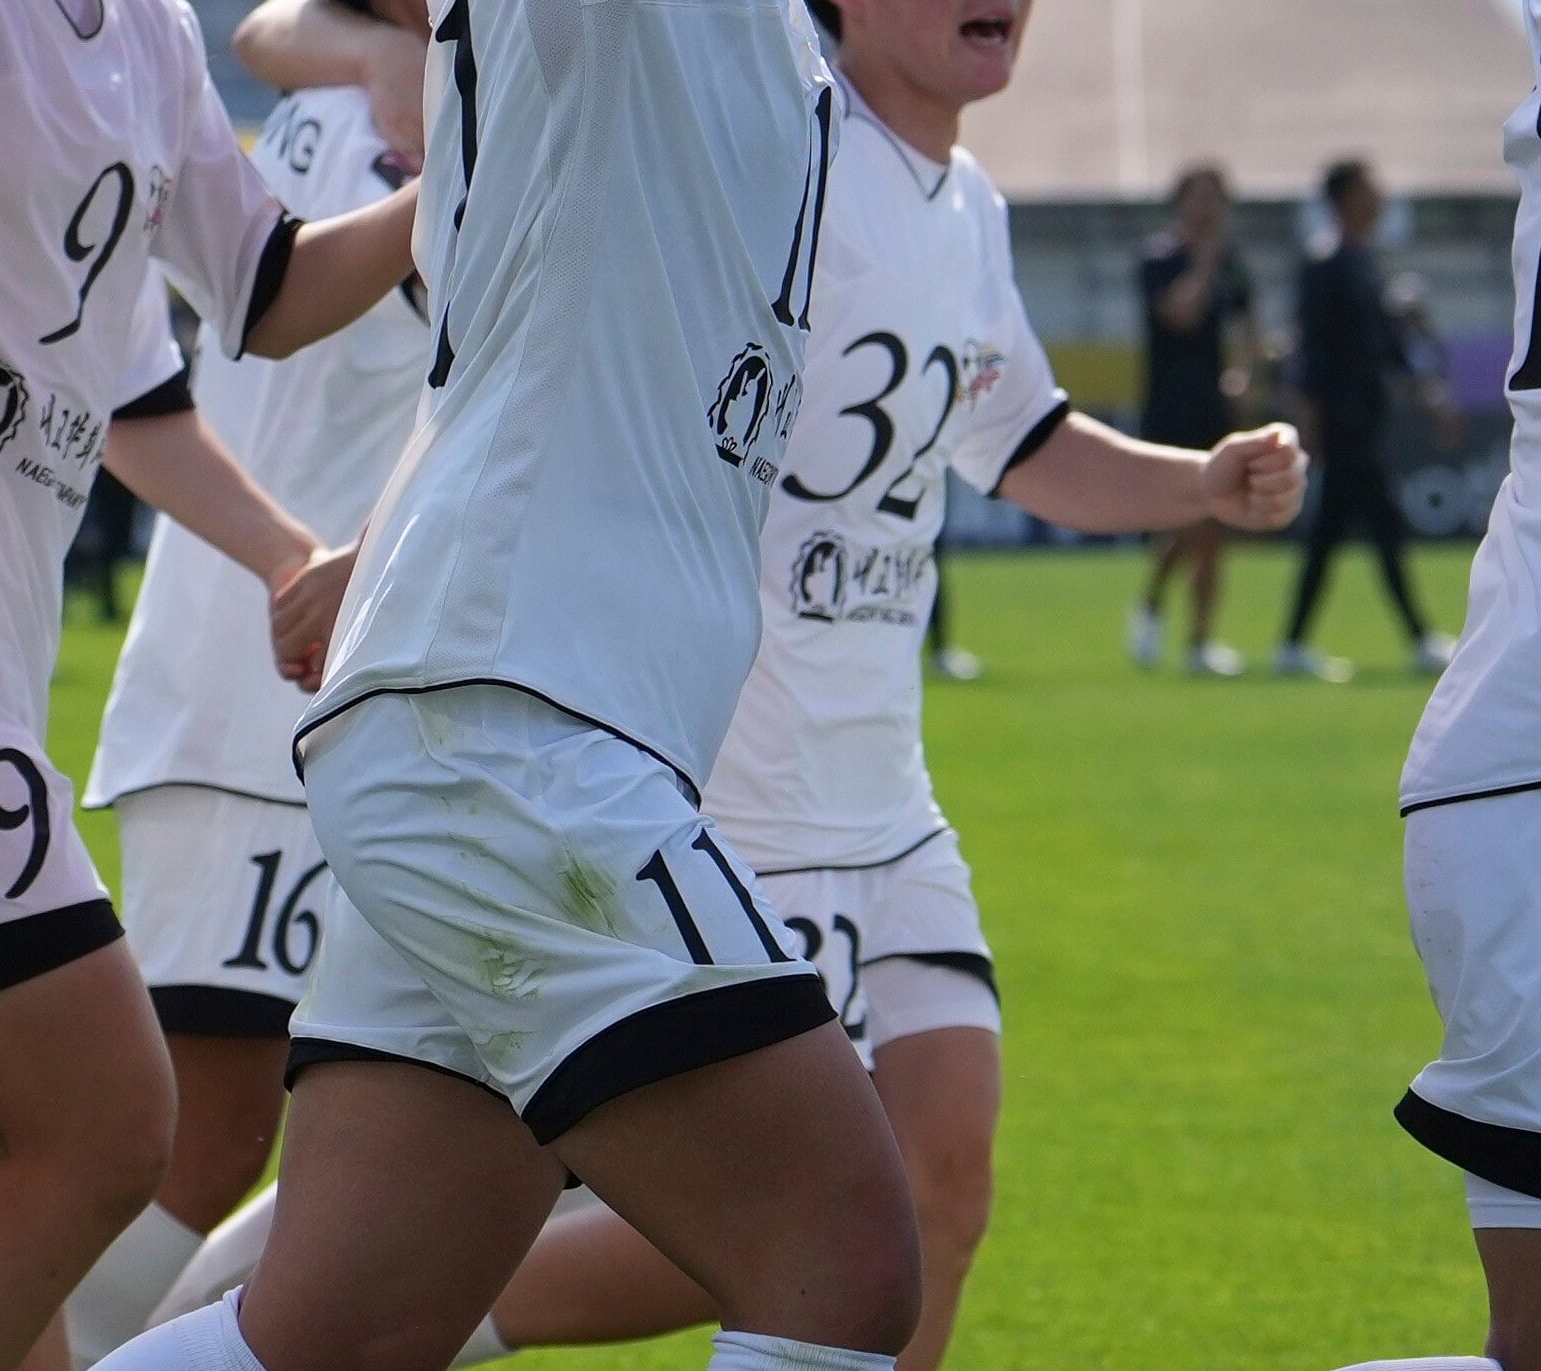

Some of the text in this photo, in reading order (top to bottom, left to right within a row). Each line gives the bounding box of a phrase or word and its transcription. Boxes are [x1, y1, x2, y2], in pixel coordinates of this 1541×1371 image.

[37, 160, 135, 345] 9
[781, 331, 959, 522] 32
[222, 848, 328, 976] 16
[635, 826, 798, 966] 11
